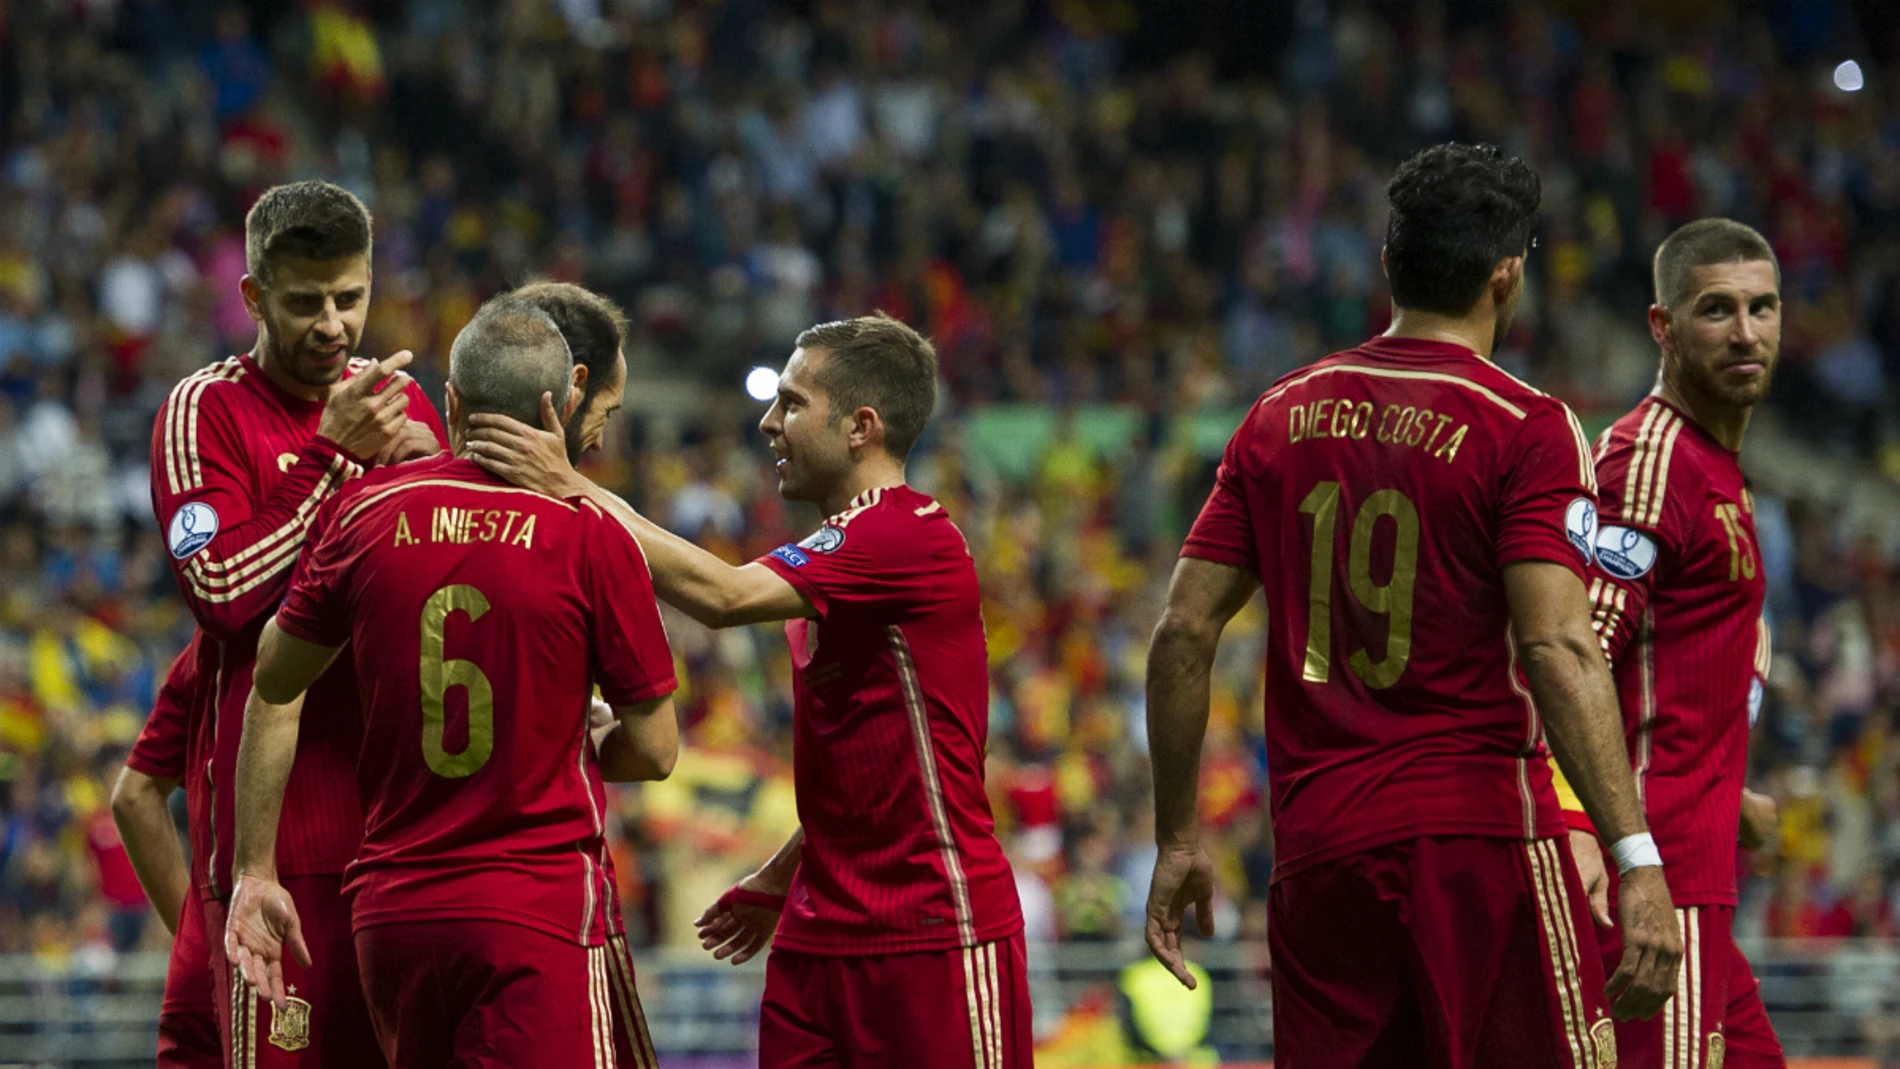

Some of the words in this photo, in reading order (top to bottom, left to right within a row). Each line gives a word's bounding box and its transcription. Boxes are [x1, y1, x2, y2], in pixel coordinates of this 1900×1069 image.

[1289, 399, 1374, 444] DIEGO
[1376, 404, 1469, 464] COSTA
[394, 511, 420, 547] A.
[431, 506, 537, 549] INIESTA
[1715, 503, 1755, 582] 15
[1298, 480, 1420, 690] 19
[419, 584, 494, 779] 6
